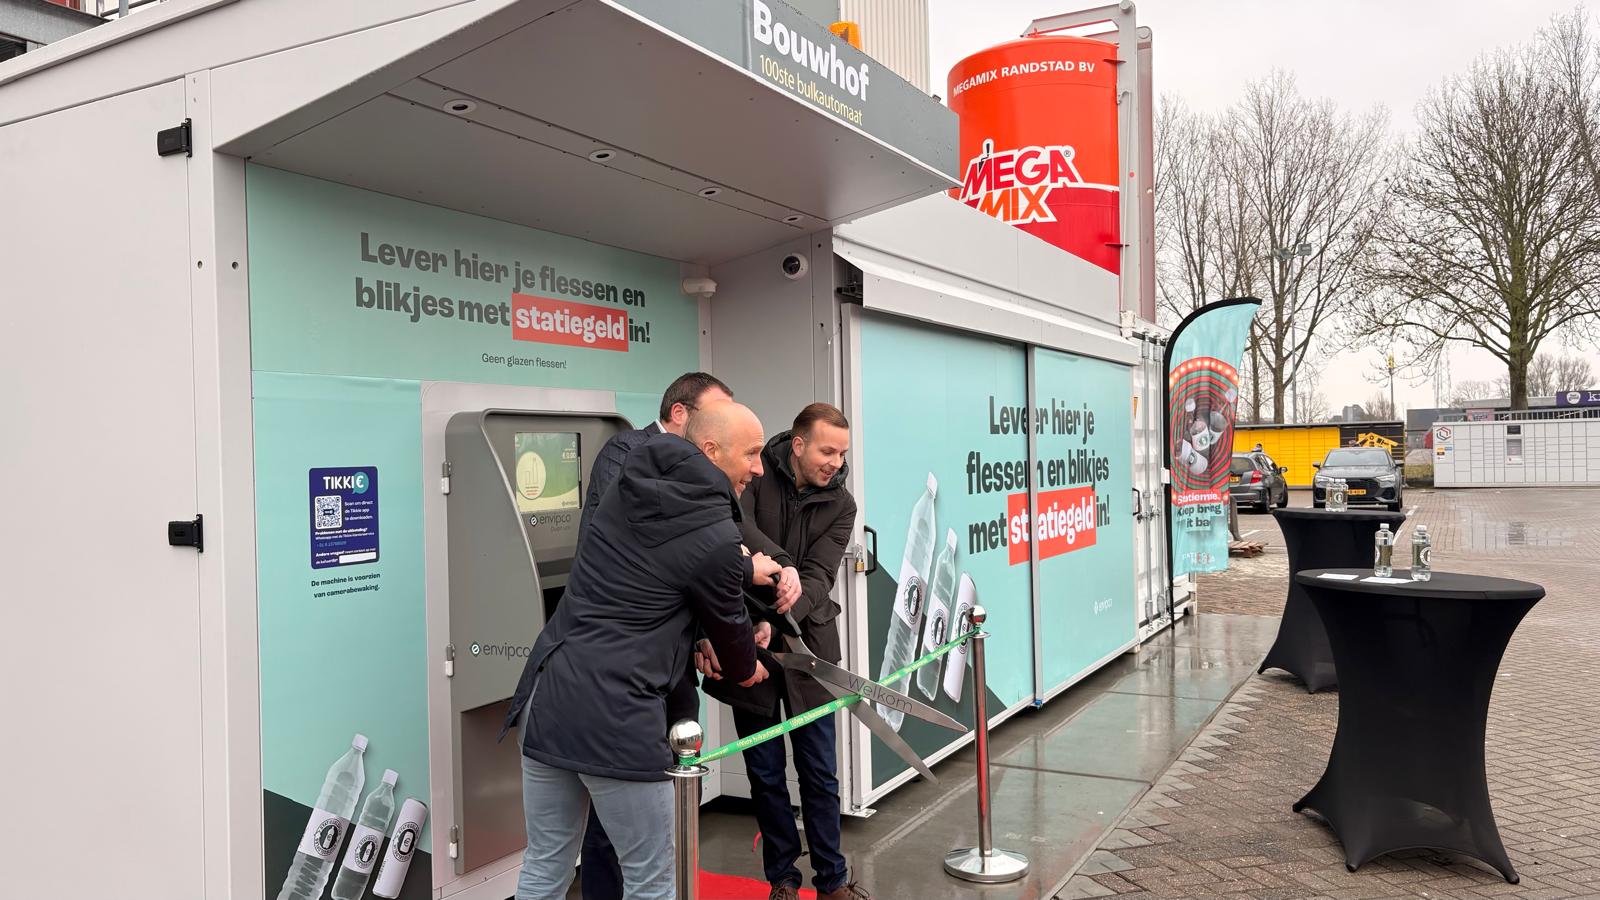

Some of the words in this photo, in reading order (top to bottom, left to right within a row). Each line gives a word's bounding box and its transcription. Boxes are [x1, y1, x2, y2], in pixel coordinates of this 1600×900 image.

[753, 0, 869, 101] Bouwhof
[760, 54, 795, 90] 100ste
[797, 72, 863, 126] bulkautomaat
[953, 69, 998, 97] MEGAMIX
[1001, 61, 1074, 78] RANDSTAD
[1078, 62, 1095, 73] BV
[979, 185, 1049, 222] MIX
[360, 232, 448, 273] Lever
[454, 249, 509, 283] hier
[512, 261, 535, 293] je
[538, 265, 618, 304] flessen
[622, 287, 646, 308] en
[355, 277, 455, 322] blikjes
[458, 299, 510, 327] met
[515, 306, 625, 343] statiegeld
[629, 319, 651, 343] in!
[481, 353, 506, 365] Geen
[507, 356, 534, 368] glazen
[535, 357, 568, 369] flessen!
[989, 396, 1049, 435] Lever
[1052, 398, 1081, 435] hier
[1082, 403, 1095, 445] je
[966, 451, 1045, 495] flessen
[1047, 458, 1066, 487] en
[1069, 449, 1109, 492] blikjes
[539, 513, 571, 526] envipco
[969, 513, 1008, 554] met
[1011, 496, 1094, 545] statiegeld
[1096, 494, 1111, 528] in!
[311, 579, 320, 587] De
[321, 576, 347, 586] machine
[354, 572, 381, 582] voorzien
[326, 583, 381, 597] camerabewaking.
[483, 642, 531, 661] envipco
[849, 678, 913, 710] Welkom
